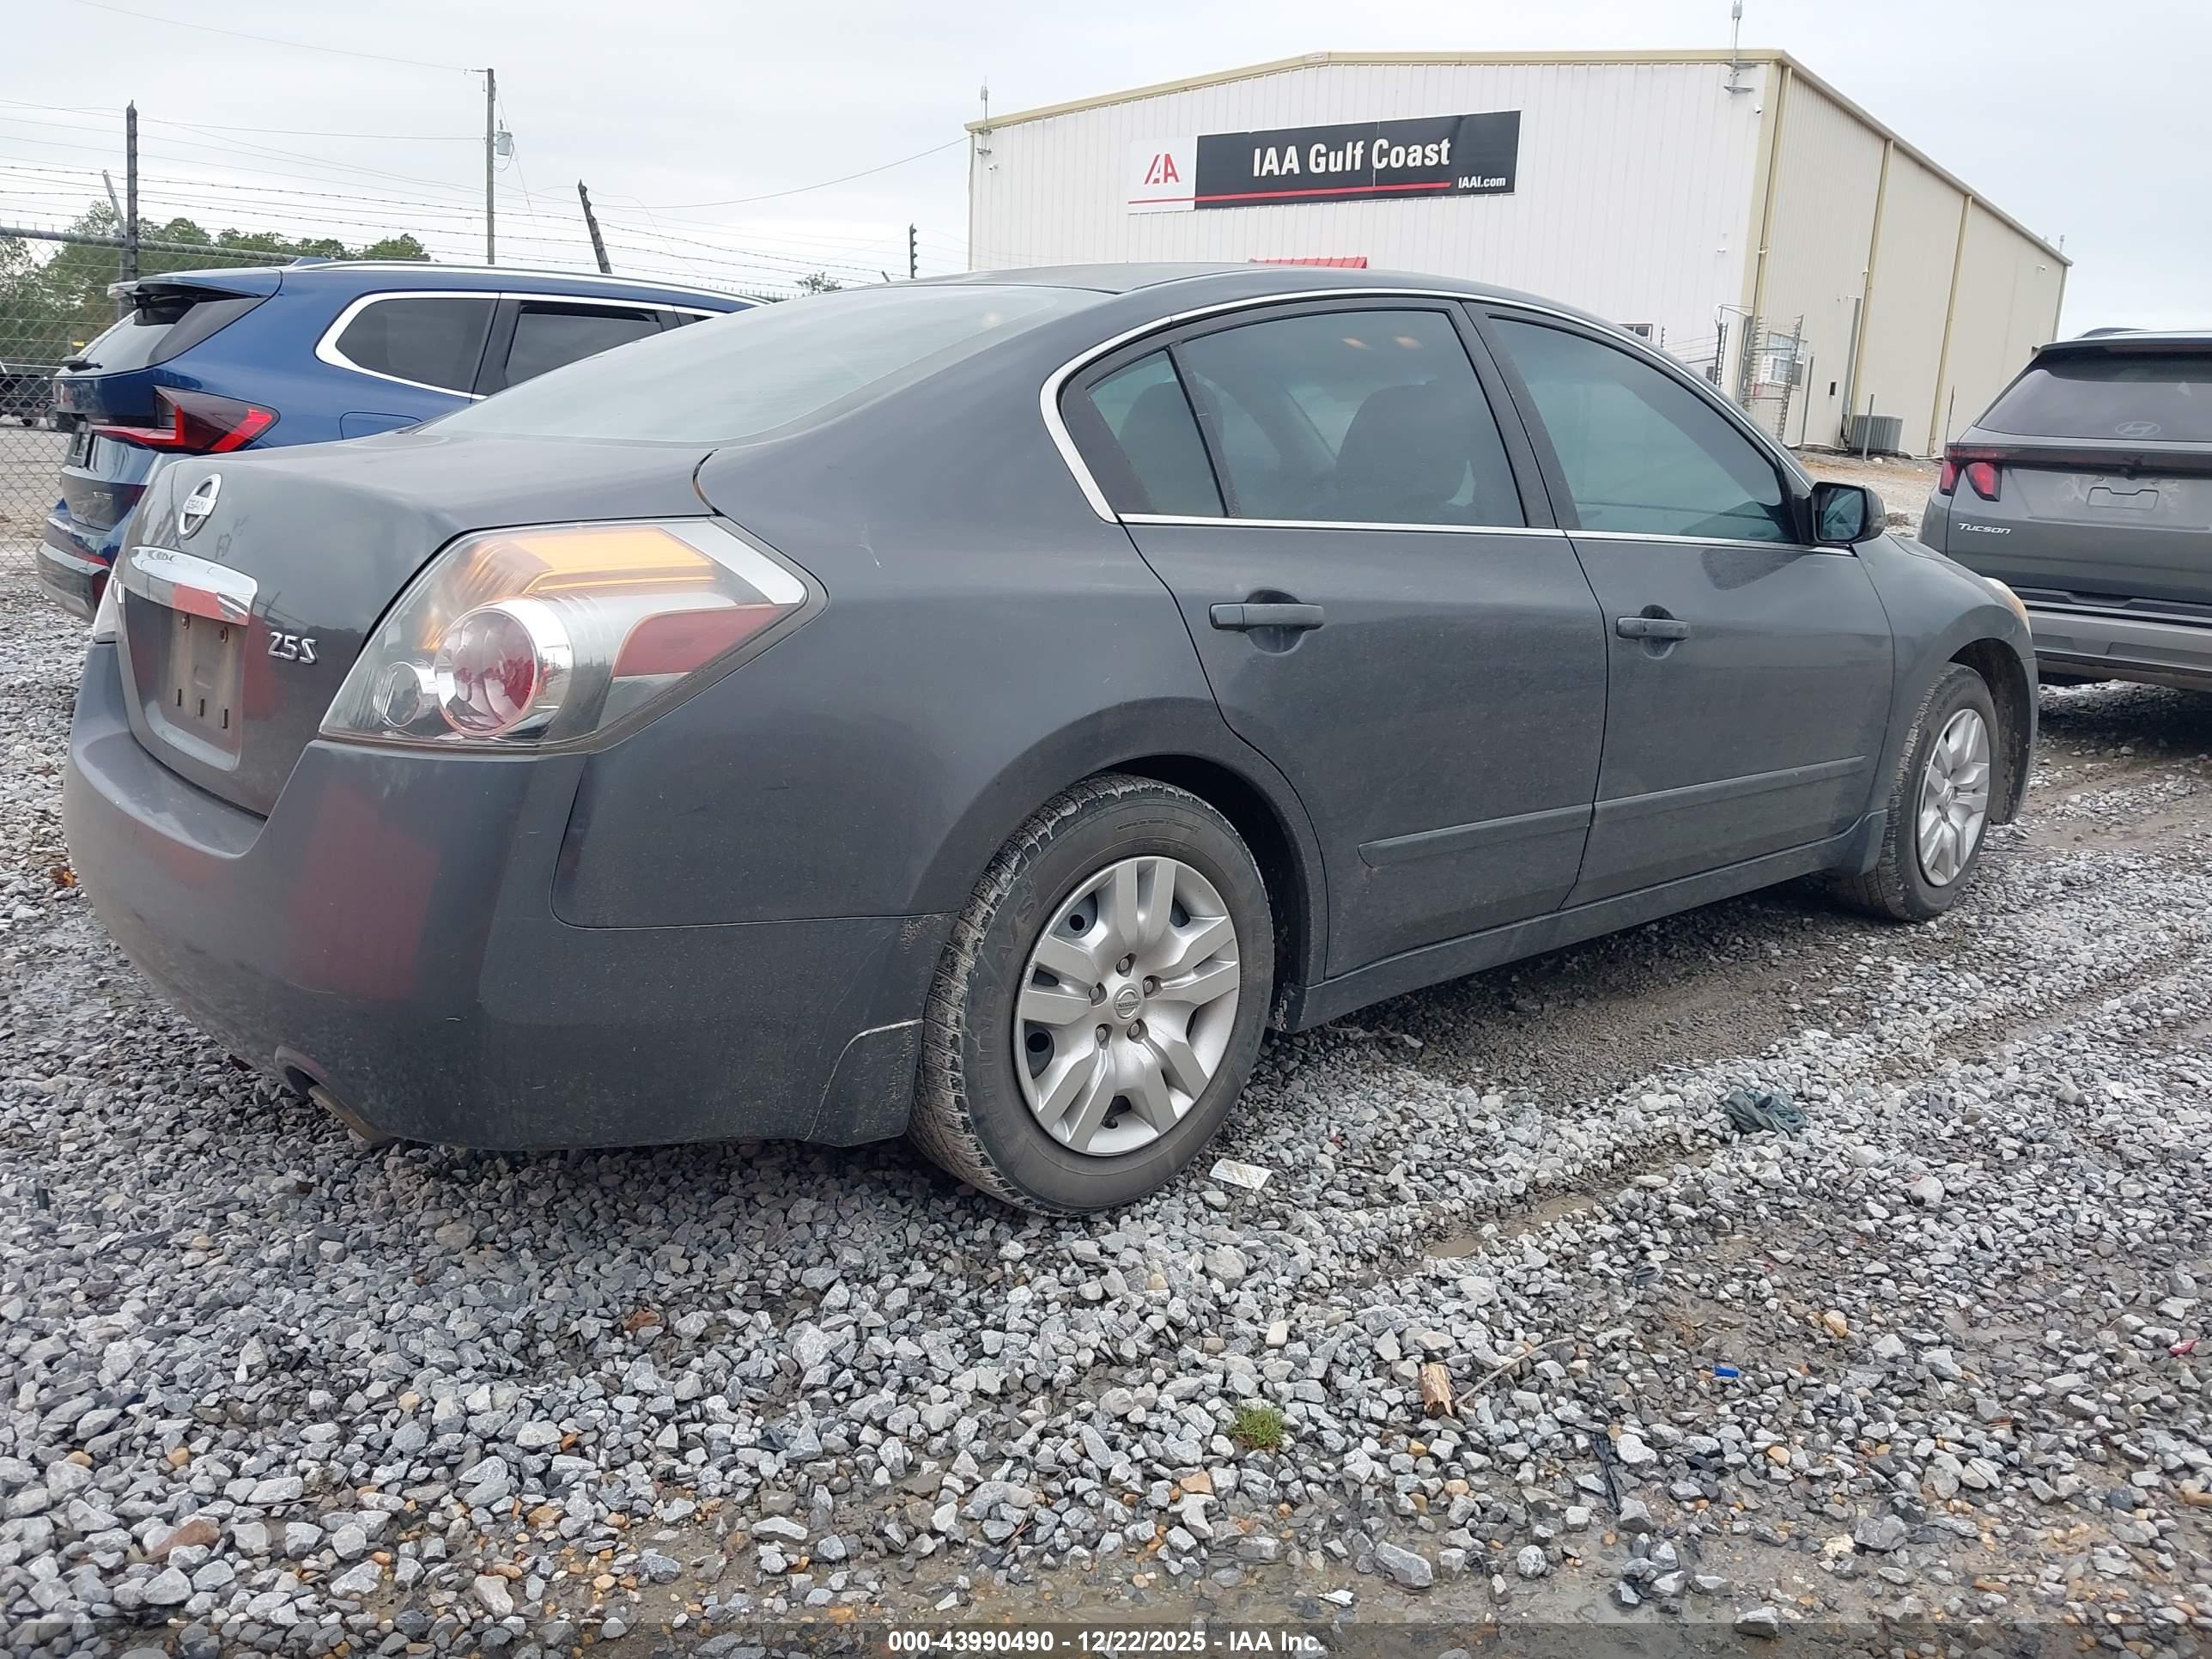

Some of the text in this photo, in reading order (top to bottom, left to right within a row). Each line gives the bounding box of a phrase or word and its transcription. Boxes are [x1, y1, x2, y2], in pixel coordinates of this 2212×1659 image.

[1252, 137, 1451, 177] IAA Gulf Coast
[1458, 175, 1506, 189] IAAI.com
[1958, 522, 2012, 534] Tucson
